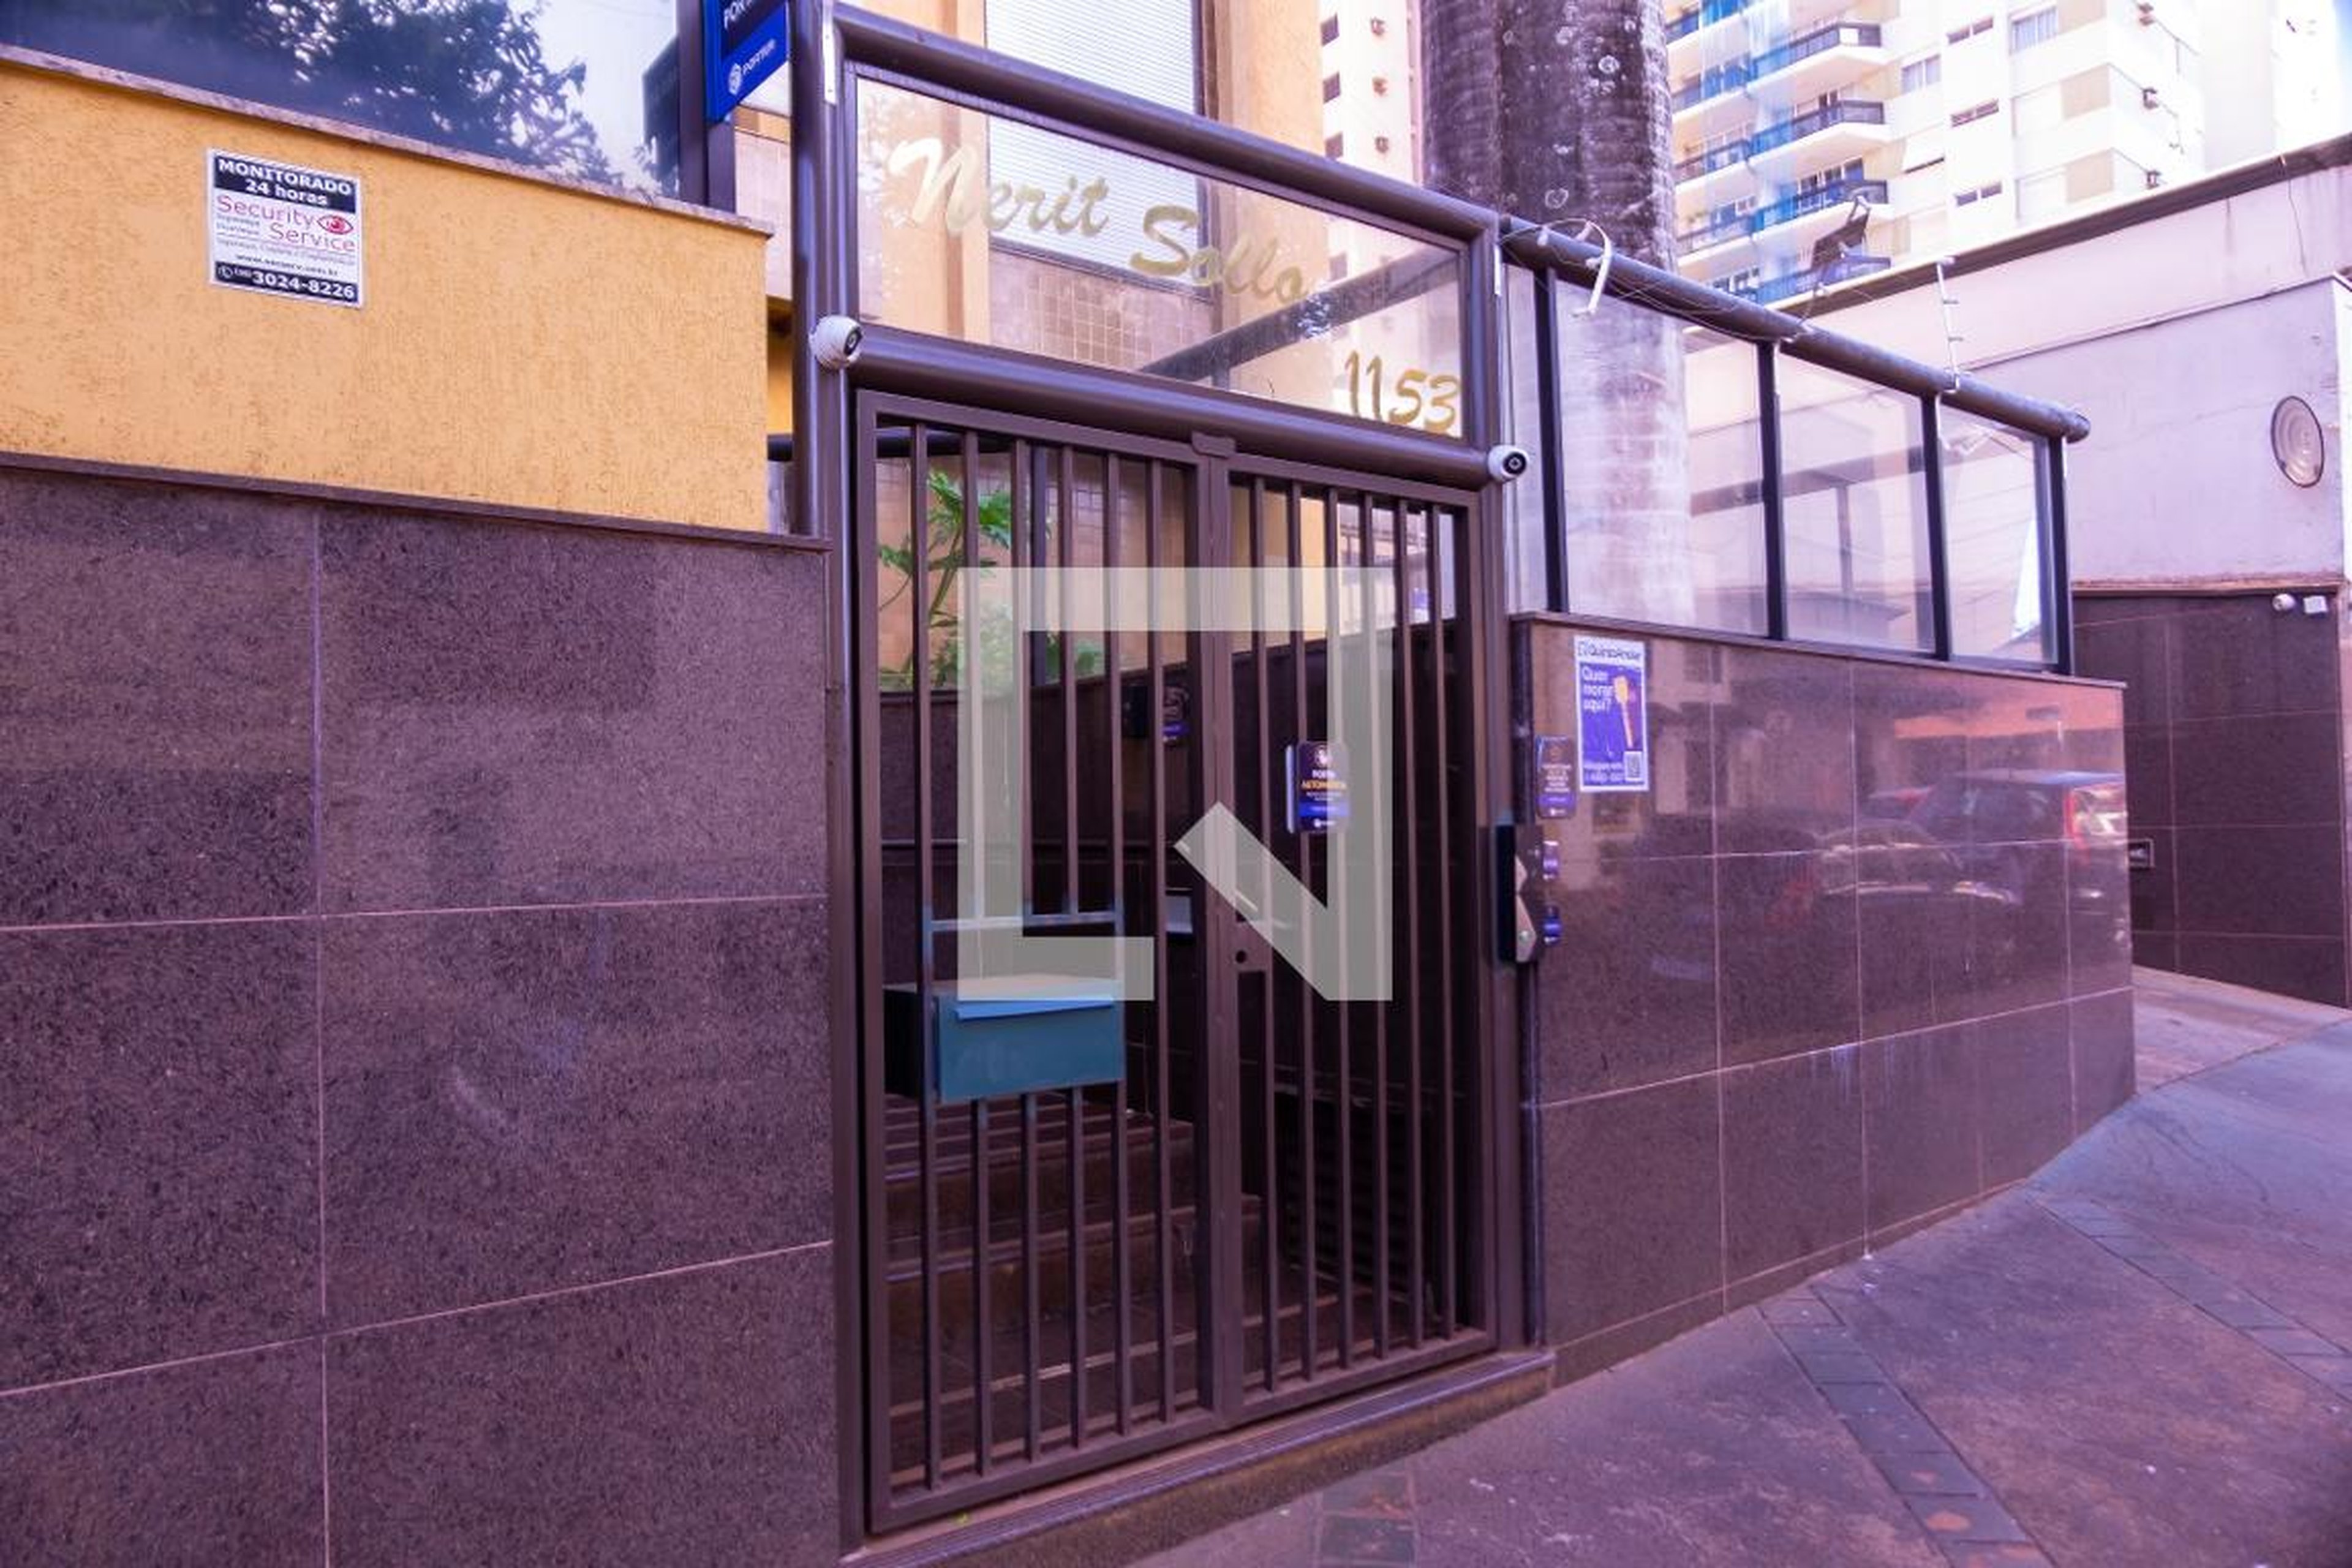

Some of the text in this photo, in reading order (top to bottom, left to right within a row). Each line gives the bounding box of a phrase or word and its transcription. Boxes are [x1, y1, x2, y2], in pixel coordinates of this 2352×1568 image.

[217, 159, 352, 195] MONITORADO
[245, 178, 328, 205] 24 horas
[216, 194, 316, 227] Security
[269, 222, 356, 252] Service
[252, 270, 355, 299] 3024-8226
[1344, 349, 1461, 434] 1153
